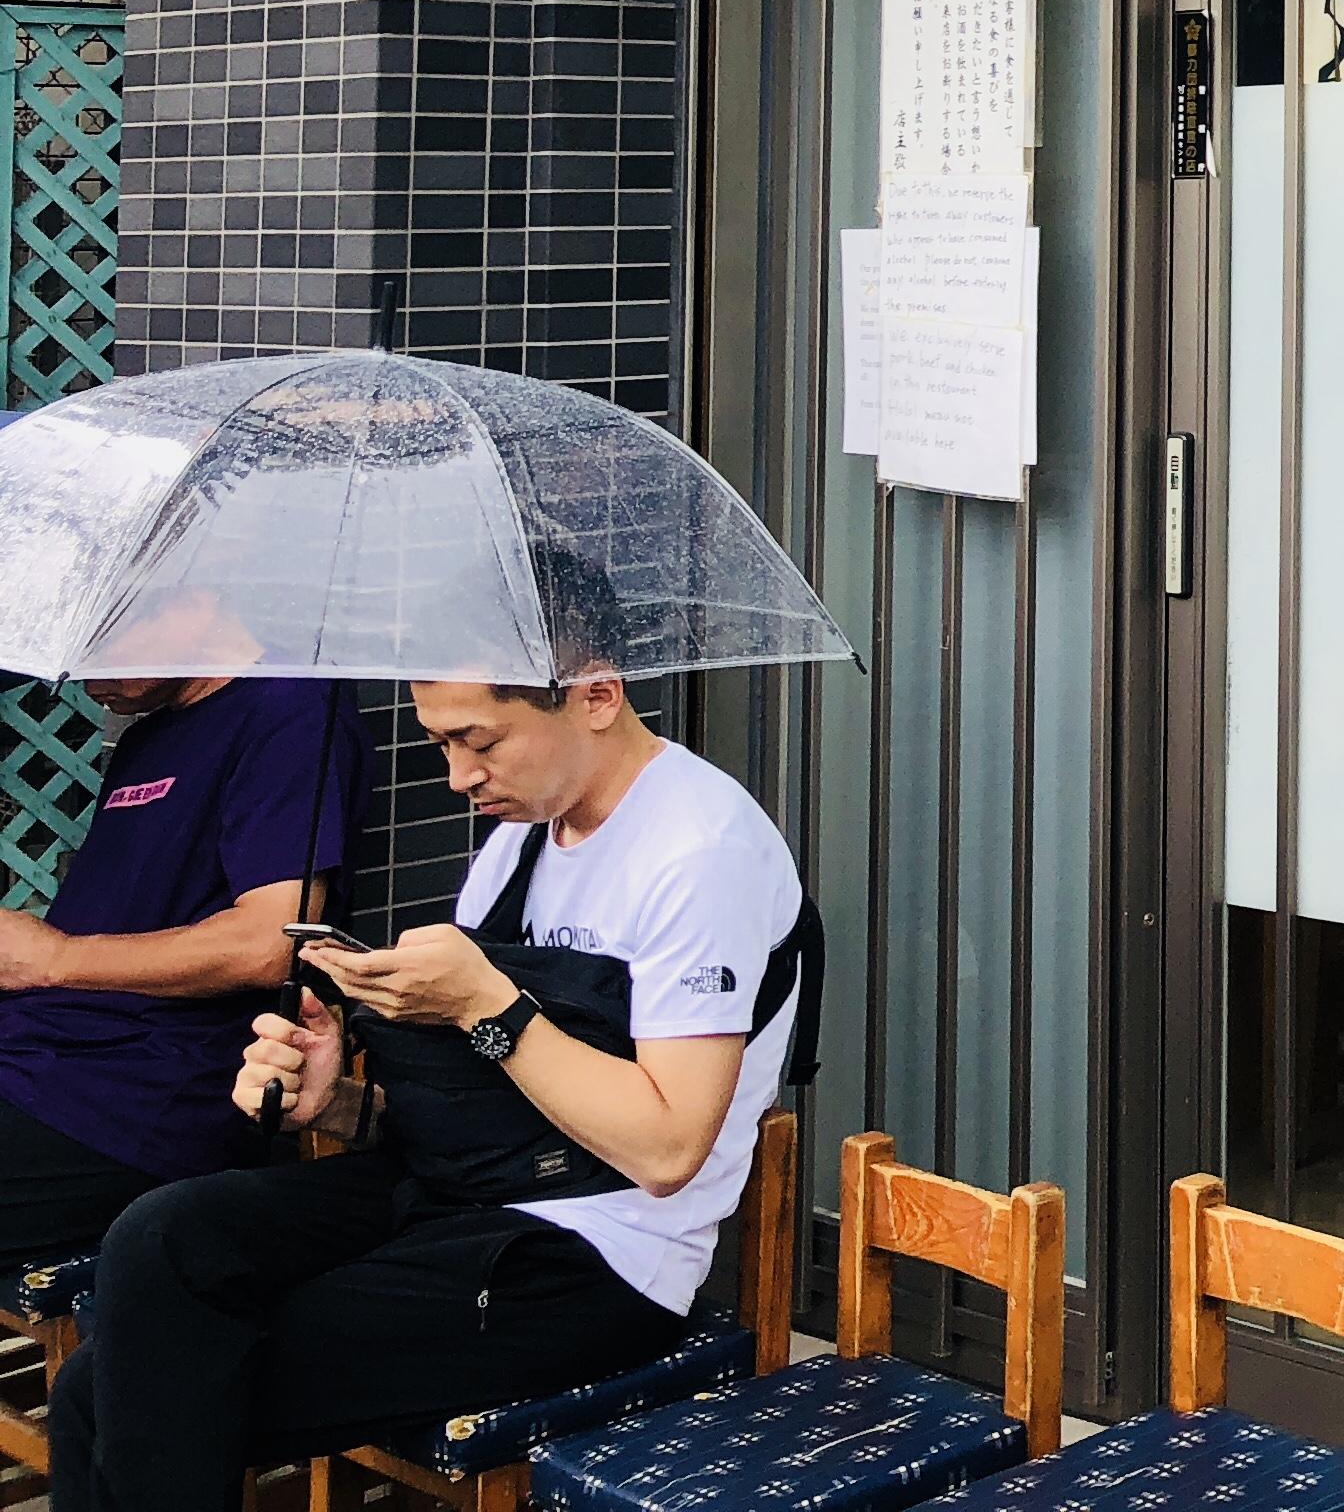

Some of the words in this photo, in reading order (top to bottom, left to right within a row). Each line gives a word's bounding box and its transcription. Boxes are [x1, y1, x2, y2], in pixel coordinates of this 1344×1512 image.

[698, 965, 720, 975] THE
[680, 975, 720, 987] NORTH
[691, 984, 720, 994] FACE
